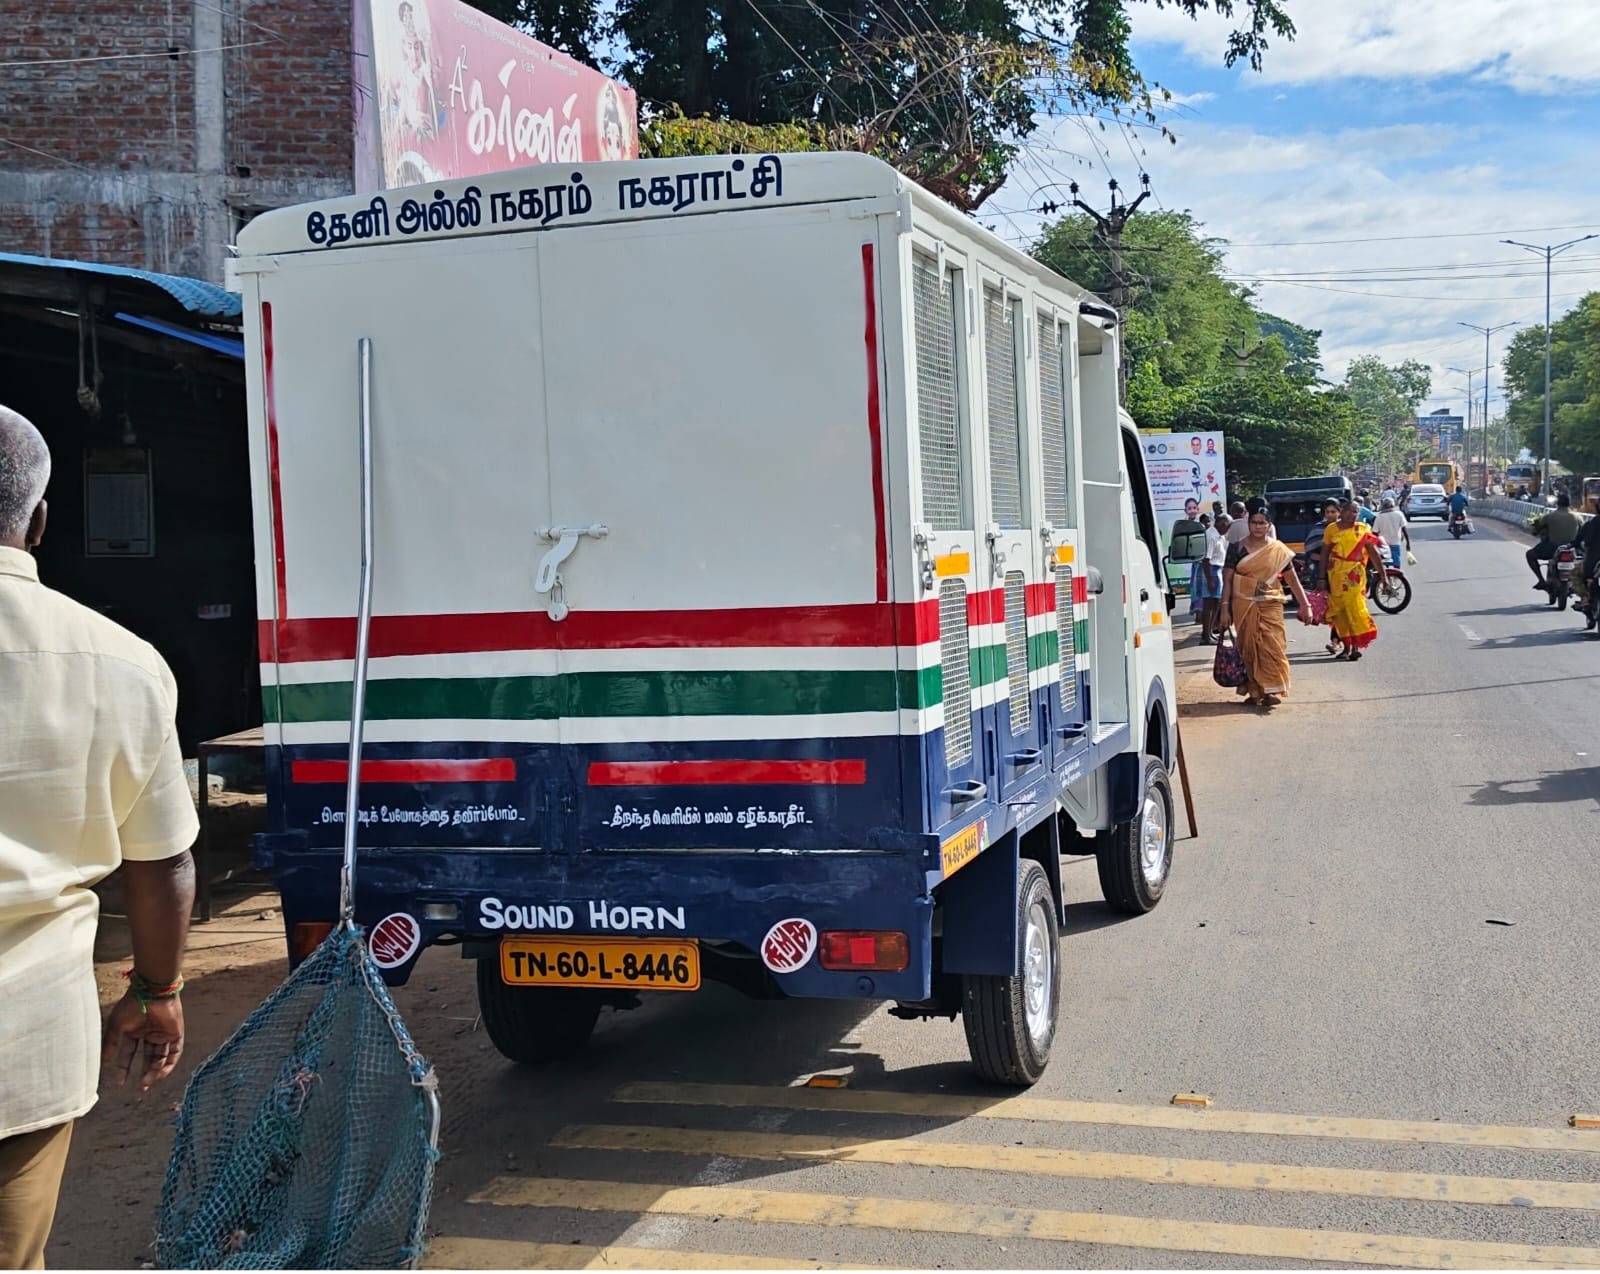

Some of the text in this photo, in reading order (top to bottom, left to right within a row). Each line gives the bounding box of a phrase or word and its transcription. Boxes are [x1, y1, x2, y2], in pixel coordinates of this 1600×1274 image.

[307, 196, 390, 247] தேனி
[618, 155, 783, 212] நகராட்சி
[509, 950, 690, 984] TN-60-L-8446
